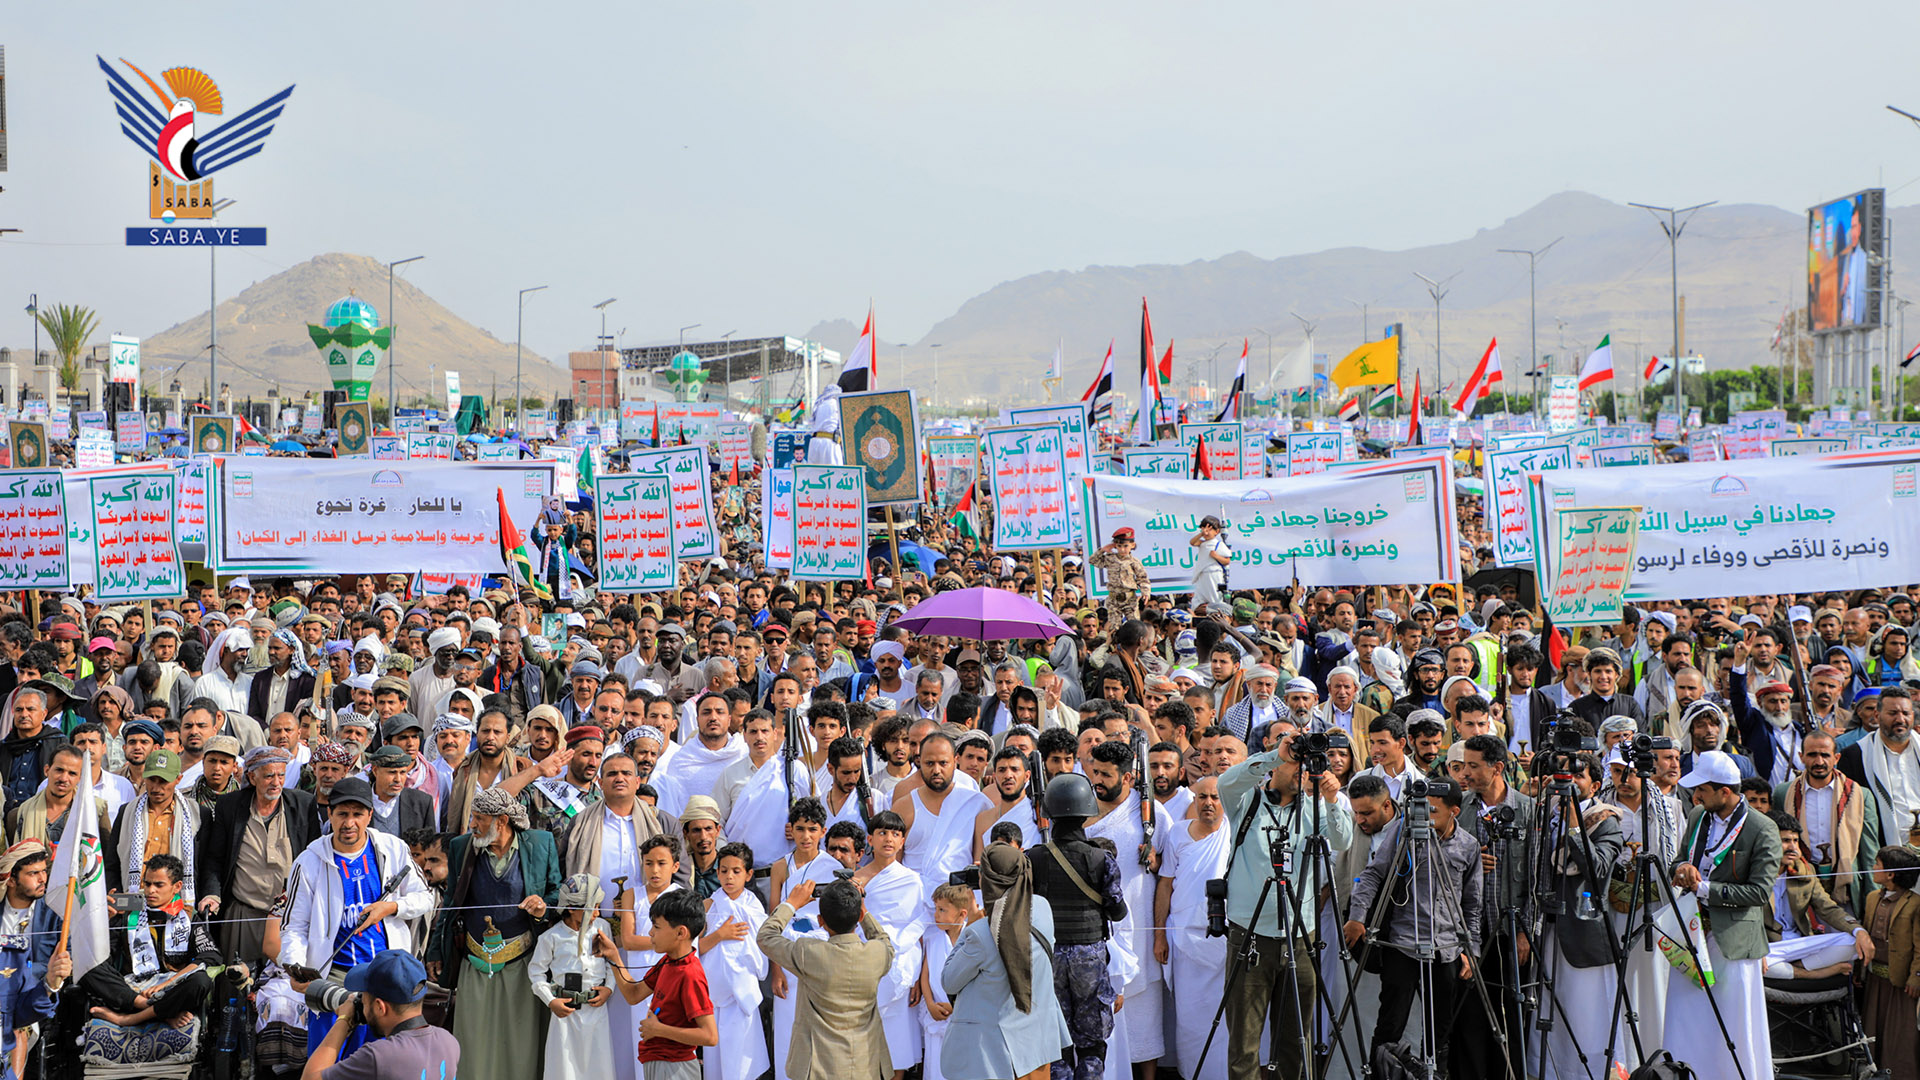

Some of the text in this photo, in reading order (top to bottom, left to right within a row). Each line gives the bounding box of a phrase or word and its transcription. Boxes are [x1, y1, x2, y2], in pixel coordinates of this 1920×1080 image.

[1059, 415, 1081, 433] قاط
[1036, 434, 1058, 453] الله
[1218, 430, 1238, 443] الله
[1293, 436, 1338, 454] الله أكبر
[996, 433, 1033, 461] أكبر
[1215, 448, 1238, 461] الموت
[190, 464, 204, 478] لله
[637, 454, 672, 474] أكب
[675, 455, 699, 473] الله
[997, 458, 1060, 477] الموت لأمريكا
[1164, 458, 1186, 473] الله
[1216, 464, 1238, 476] الموت
[1498, 453, 1567, 482] الله أكبر
[0, 477, 61, 498] الله أك
[673, 479, 701, 494] الموت
[773, 475, 791, 498] عوا
[797, 469, 860, 495] الله أكبر
[1000, 479, 1061, 498] الموت لإسرائيل
[97, 479, 171, 509] الله أكبر
[602, 480, 667, 507] الله أكبر
[797, 495, 860, 511] الموت لأمريكا
[0, 504, 62, 521] الموت لأمري
[316, 498, 353, 516] تجوع
[359, 497, 386, 516] غزة
[408, 497, 445, 516] للعار
[450, 497, 462, 516] يا
[603, 506, 668, 523] الموت لأمريكا
[675, 498, 703, 513] الموت
[1001, 499, 1063, 518] اللعنة على اليهود
[97, 509, 170, 527] الموت لأمريكا
[685, 516, 706, 528] اللعنة
[797, 515, 860, 531] الموت لإسرائيل
[1145, 509, 1179, 531] الله
[1237, 510, 1266, 537] في
[1271, 510, 1319, 529] جهاد
[1324, 503, 1389, 528] خروجنا
[1639, 503, 1836, 536] جهادنا في سبيل الله
[29, 525, 64, 541] الموت
[603, 527, 669, 543] الموت لإسرائيل
[1001, 520, 1032, 542] للإسلام
[1036, 518, 1065, 541] النصر
[1563, 513, 1608, 541] أكبر
[99, 529, 140, 548] لإسرائيل
[142, 530, 172, 546] الموت
[237, 530, 280, 547] الكيان!
[284, 530, 307, 546] إلى
[312, 530, 347, 544] الغذاء
[352, 530, 387, 545] ترسل
[391, 529, 447, 545] وإسلامية
[451, 530, 485, 545] عربية
[679, 531, 709, 553] النصر
[798, 535, 861, 550] اللعنة على اليهود
[0, 544, 65, 560] اللعنة على اليه
[604, 545, 671, 562] اللعنة على اليهود
[1141, 538, 1398, 569] ونصرة للأقصى ورسل الله
[1691, 544, 1747, 568] ووفاء
[1753, 537, 1825, 567] للأقصى
[1831, 537, 1889, 560] ونصرة
[100, 550, 175, 568] اللعنة على اليهود
[797, 552, 829, 573] للإسلام
[831, 551, 860, 572] النصر
[0, 560, 65, 584] النصر للإسلا
[102, 567, 177, 593] النصر للإسلام
[605, 562, 670, 586] النصر للإسلام
